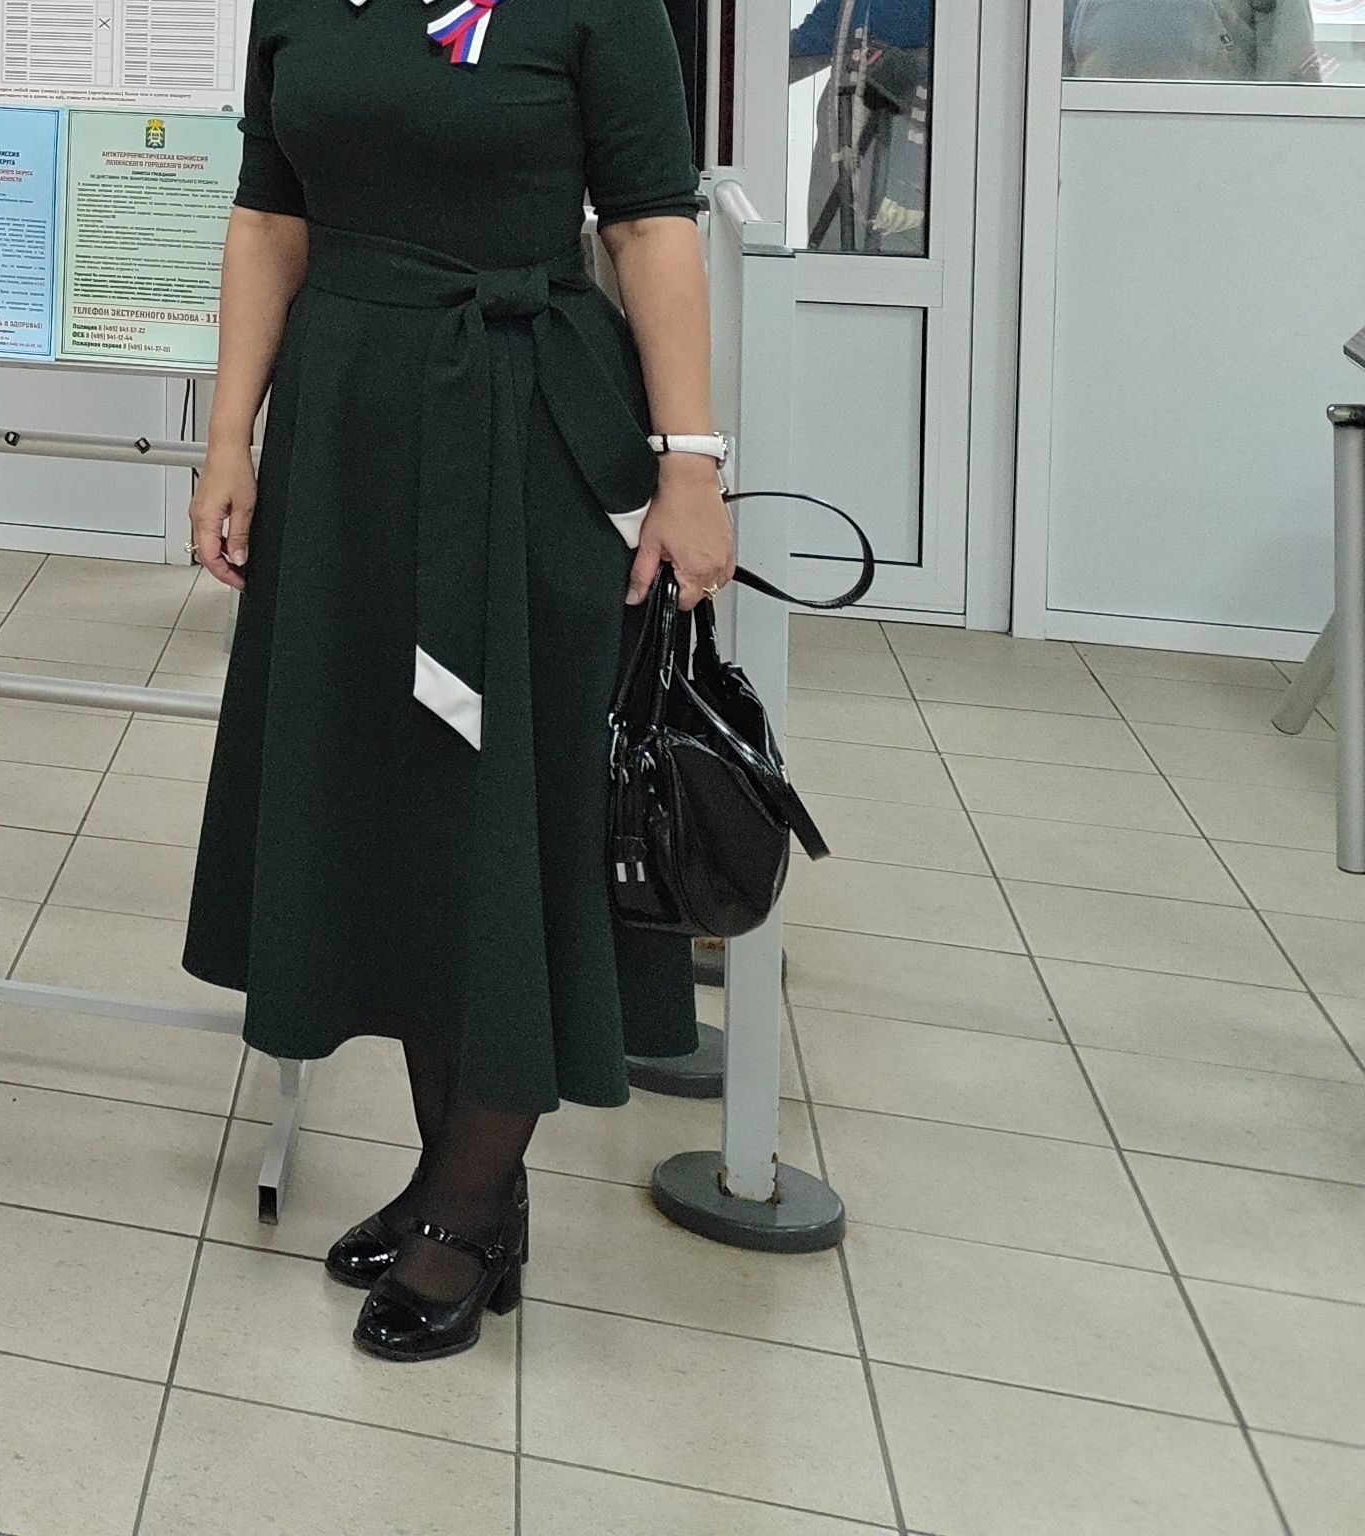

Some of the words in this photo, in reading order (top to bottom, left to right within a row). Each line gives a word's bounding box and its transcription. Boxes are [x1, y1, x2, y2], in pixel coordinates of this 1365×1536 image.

[73, 306, 109, 316] ТЕЛЕФОН
[111, 309, 165, 319] ЭКСТРЕННОГО
[168, 313, 199, 322] ВЫЗОВА
[206, 314, 219, 324] 11
